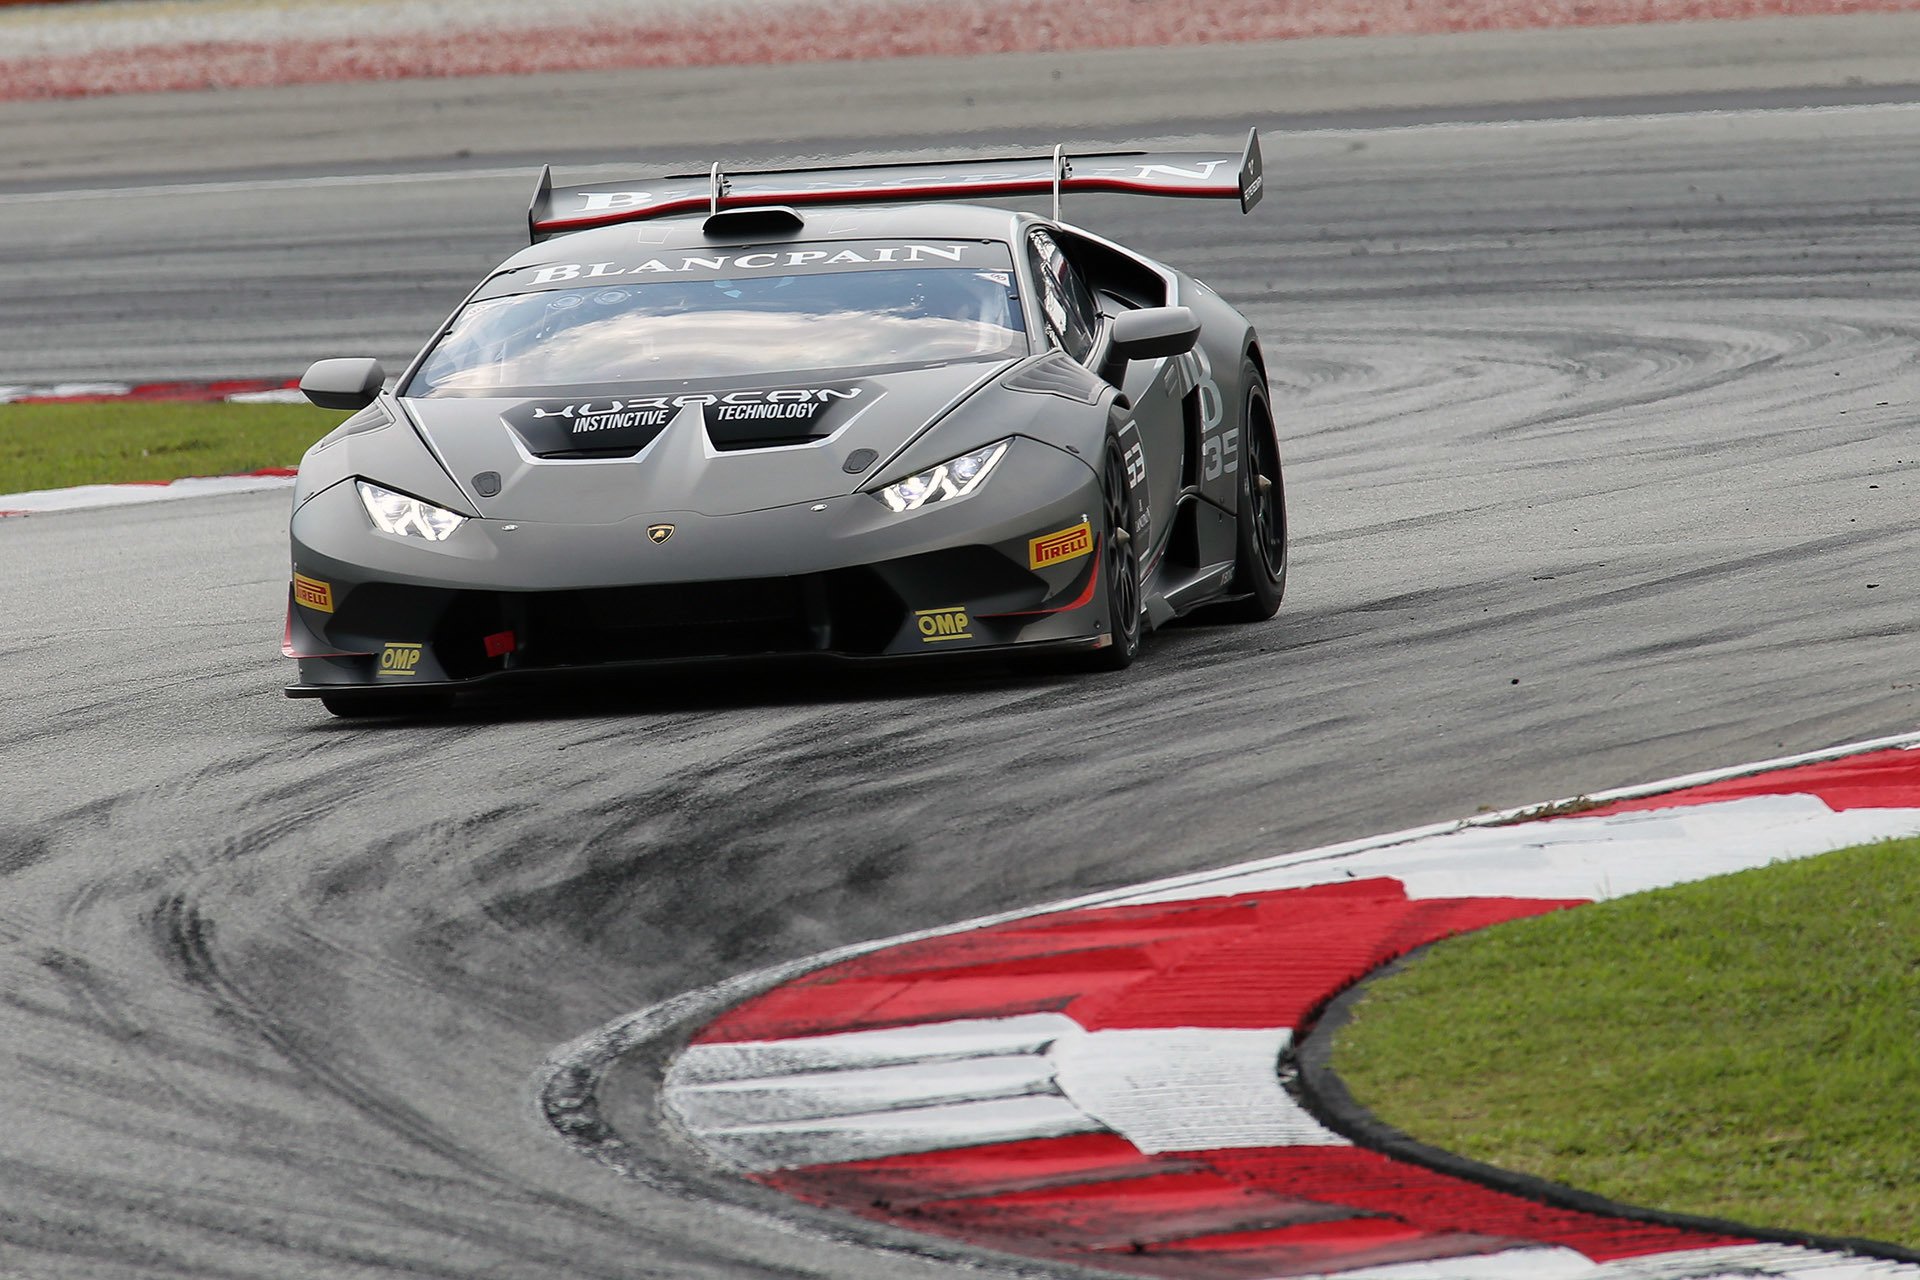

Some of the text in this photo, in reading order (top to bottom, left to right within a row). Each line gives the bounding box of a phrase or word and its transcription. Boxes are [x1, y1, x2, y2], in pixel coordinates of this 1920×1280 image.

[525, 245, 969, 287] BLANCPAIN
[573, 402, 819, 433] INSTINCTIVE TECHNOLOGY
[1036, 528, 1088, 562] PIRELLI
[296, 579, 328, 606] PIRELLI
[918, 613, 968, 635] OMP
[381, 648, 421, 670] OMP
